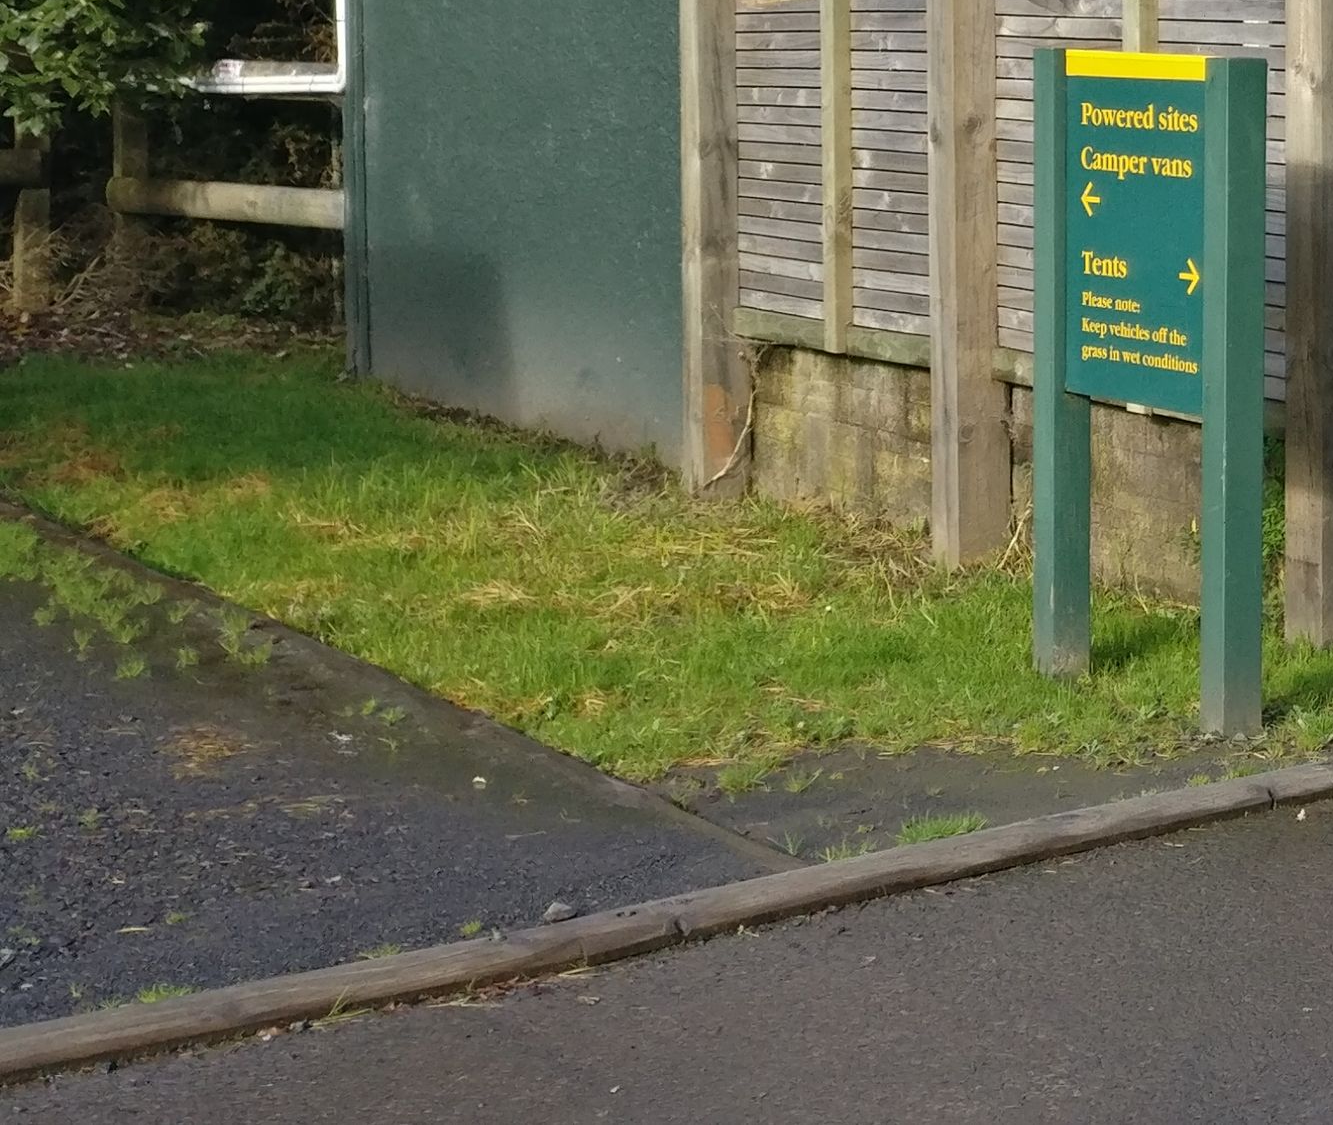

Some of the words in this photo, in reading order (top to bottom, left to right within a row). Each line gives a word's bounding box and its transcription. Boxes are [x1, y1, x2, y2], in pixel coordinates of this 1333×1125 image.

[1081, 102, 1154, 129] Powered
[1158, 106, 1198, 132] sites
[1081, 146, 1148, 180] Camper
[1151, 157, 1193, 178] vans
[1081, 251, 1128, 279] Tents
[1082, 291, 1113, 309] Please
[1115, 299, 1141, 313] note:
[1082, 317, 1107, 338] Keep
[1109, 322, 1150, 341] vehicles
[1152, 327, 1169, 344] off
[1169, 329, 1187, 347] the
[1081, 345, 1107, 361] grass
[1109, 346, 1120, 362] in
[1122, 350, 1141, 365] wet
